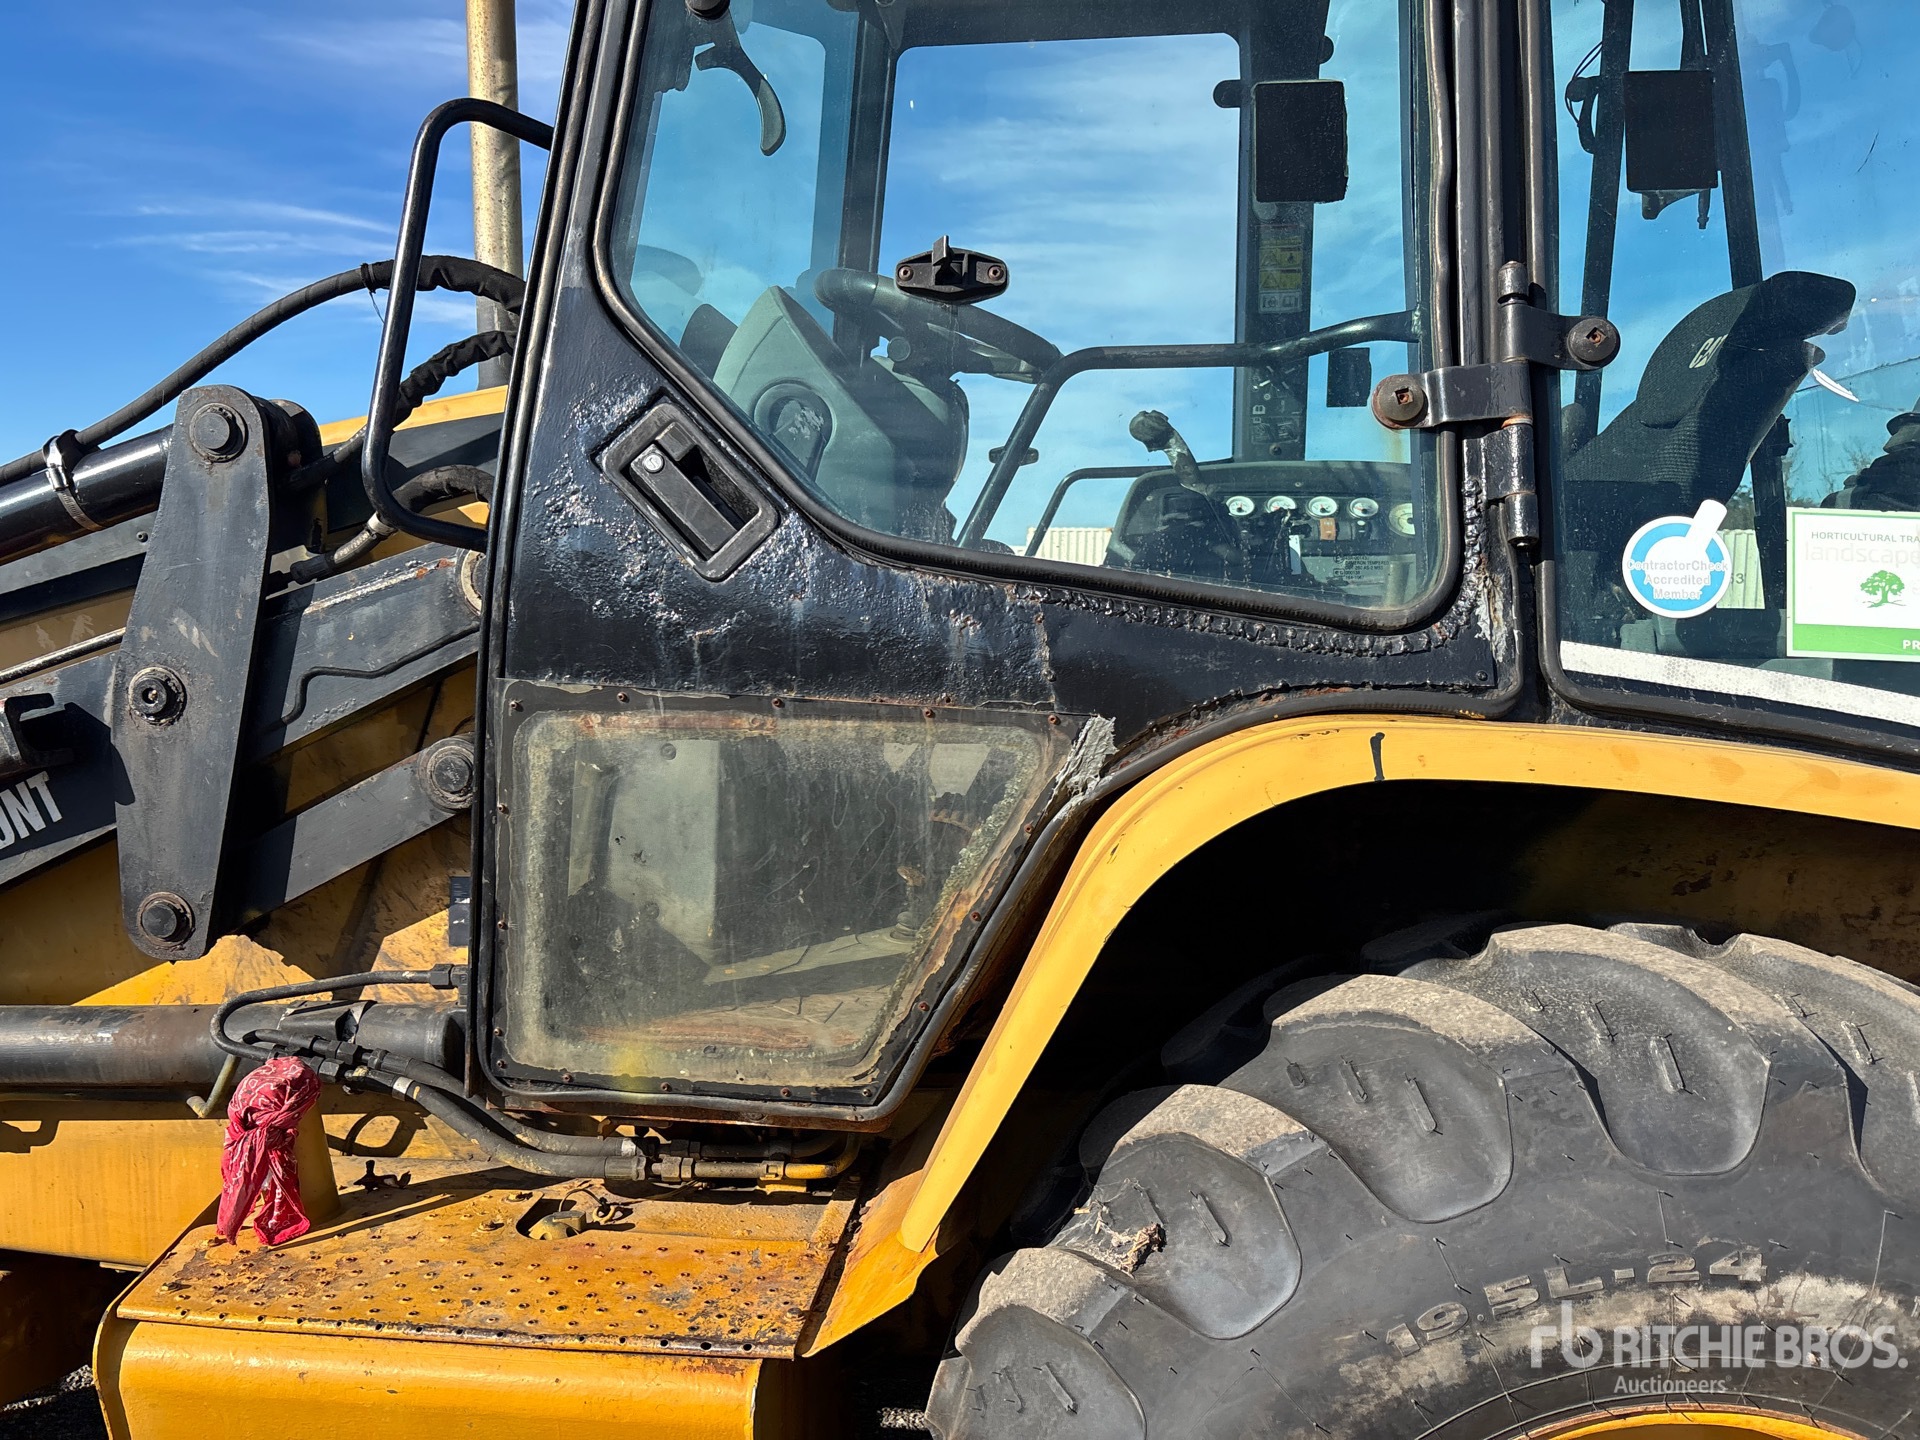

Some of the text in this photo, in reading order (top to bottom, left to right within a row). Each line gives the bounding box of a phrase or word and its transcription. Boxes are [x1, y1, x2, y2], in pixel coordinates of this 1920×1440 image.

[1811, 531, 1920, 543] HORTICULTURAL TRA
[1626, 559, 1729, 571] ContractorCheck
[1645, 574, 1711, 585] Accredited
[1653, 588, 1702, 599] Member
[1902, 639, 1920, 650] PR
[1385, 1250, 1768, 1357] 19.5L-24
